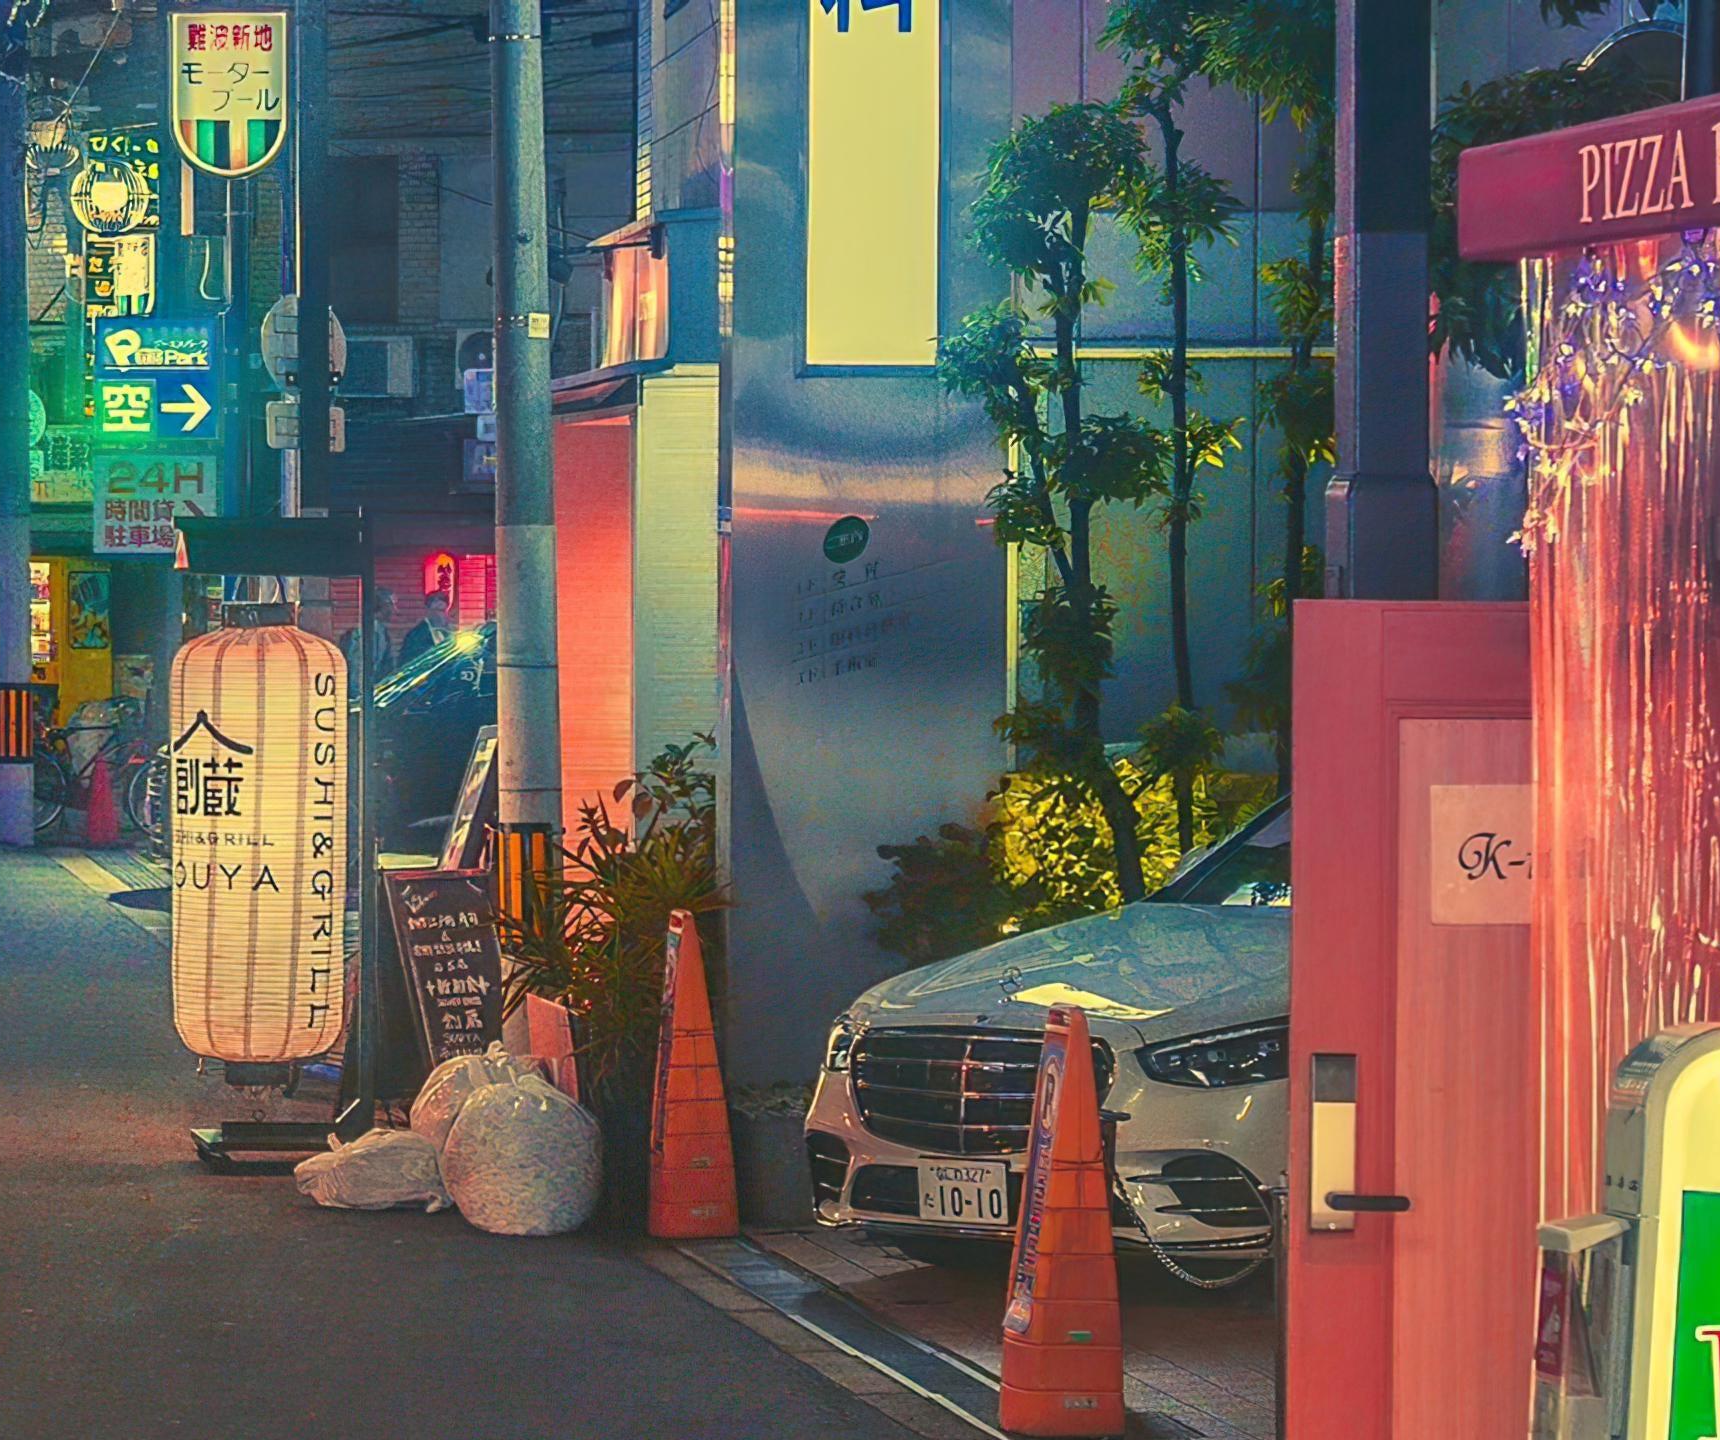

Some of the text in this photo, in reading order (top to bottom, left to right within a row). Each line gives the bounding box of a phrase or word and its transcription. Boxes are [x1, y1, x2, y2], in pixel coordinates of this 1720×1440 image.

[187, 24, 272, 52] 難波新地
[180, 62, 270, 84] モーター
[1578, 129, 1695, 224] PIZZA
[101, 383, 150, 432] 空
[107, 461, 204, 494] 24H
[105, 500, 176, 522] 時間貸
[104, 524, 177, 549] 駐車場
[309, 672, 338, 1030] SUSHI&GRILL
[939, 1185, 1003, 1219] 10-10
